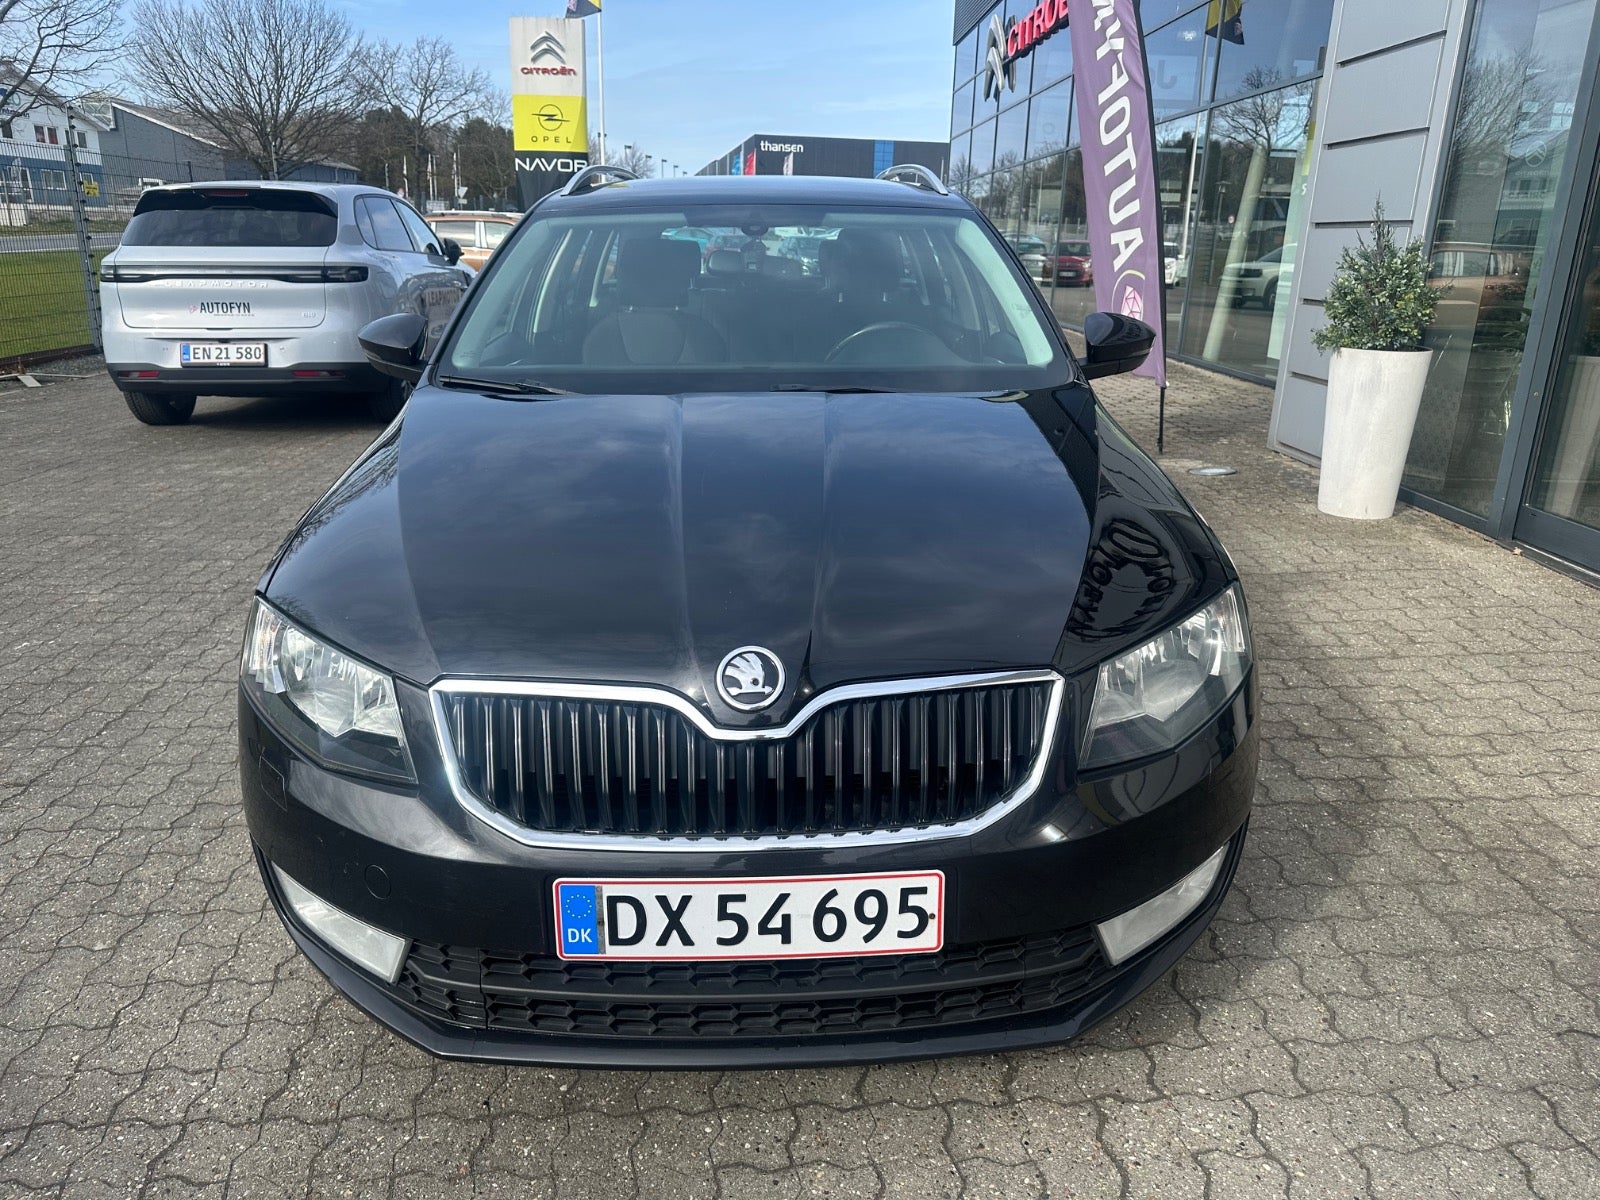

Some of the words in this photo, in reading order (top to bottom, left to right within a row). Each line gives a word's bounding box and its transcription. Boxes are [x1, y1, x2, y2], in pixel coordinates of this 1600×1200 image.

[530, 135, 572, 144] OPEL
[760, 140, 804, 153] thansen
[199, 301, 251, 315] AUTOFYN
[192, 347, 212, 360] EN
[215, 347, 231, 360] 21
[235, 347, 262, 360] 580
[606, 894, 696, 948] DX
[716, 892, 793, 947] 54
[811, 885, 930, 945] 695
[567, 927, 593, 944] DK
